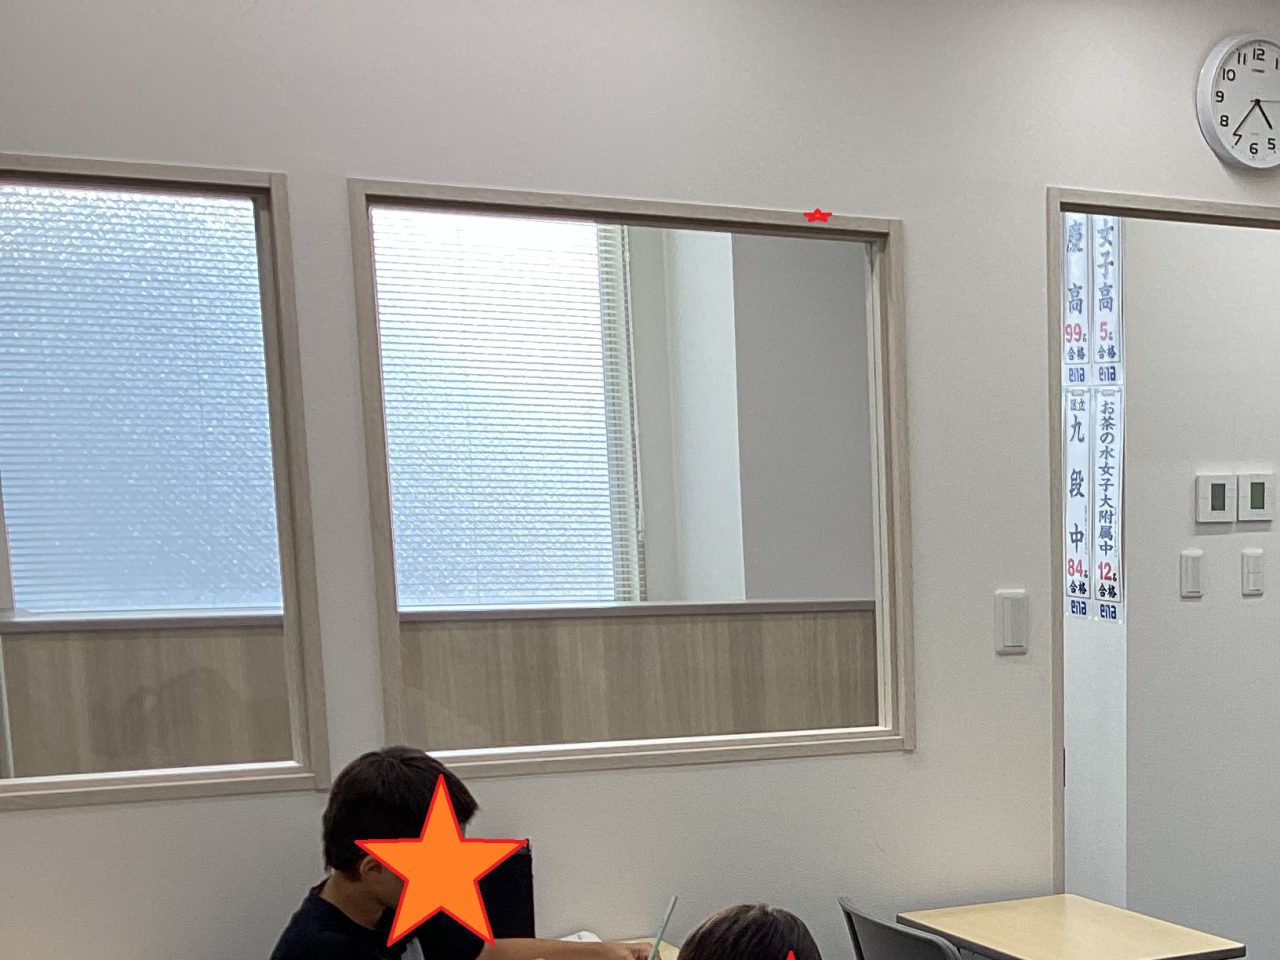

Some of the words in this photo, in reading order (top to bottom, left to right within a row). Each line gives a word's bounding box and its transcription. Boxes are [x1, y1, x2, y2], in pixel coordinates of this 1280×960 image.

[1237, 52, 1246, 65] 11
[1252, 47, 1265, 61] 12
[1222, 68, 1236, 81] 10
[1215, 90, 1225, 103] 9
[1220, 115, 1229, 127] 8
[1233, 132, 1243, 146] 7
[1267, 138, 1276, 150] 5
[1249, 142, 1259, 155] 6
[1068, 346, 1086, 360] 合格
[1097, 344, 1117, 359] 合格
[1098, 400, 1117, 556] お茶の水女子大附属中
[1069, 579, 1087, 595] 合格
[1098, 583, 1117, 598] 合格
[1070, 600, 1087, 615] ena
[1099, 603, 1117, 619] ena
